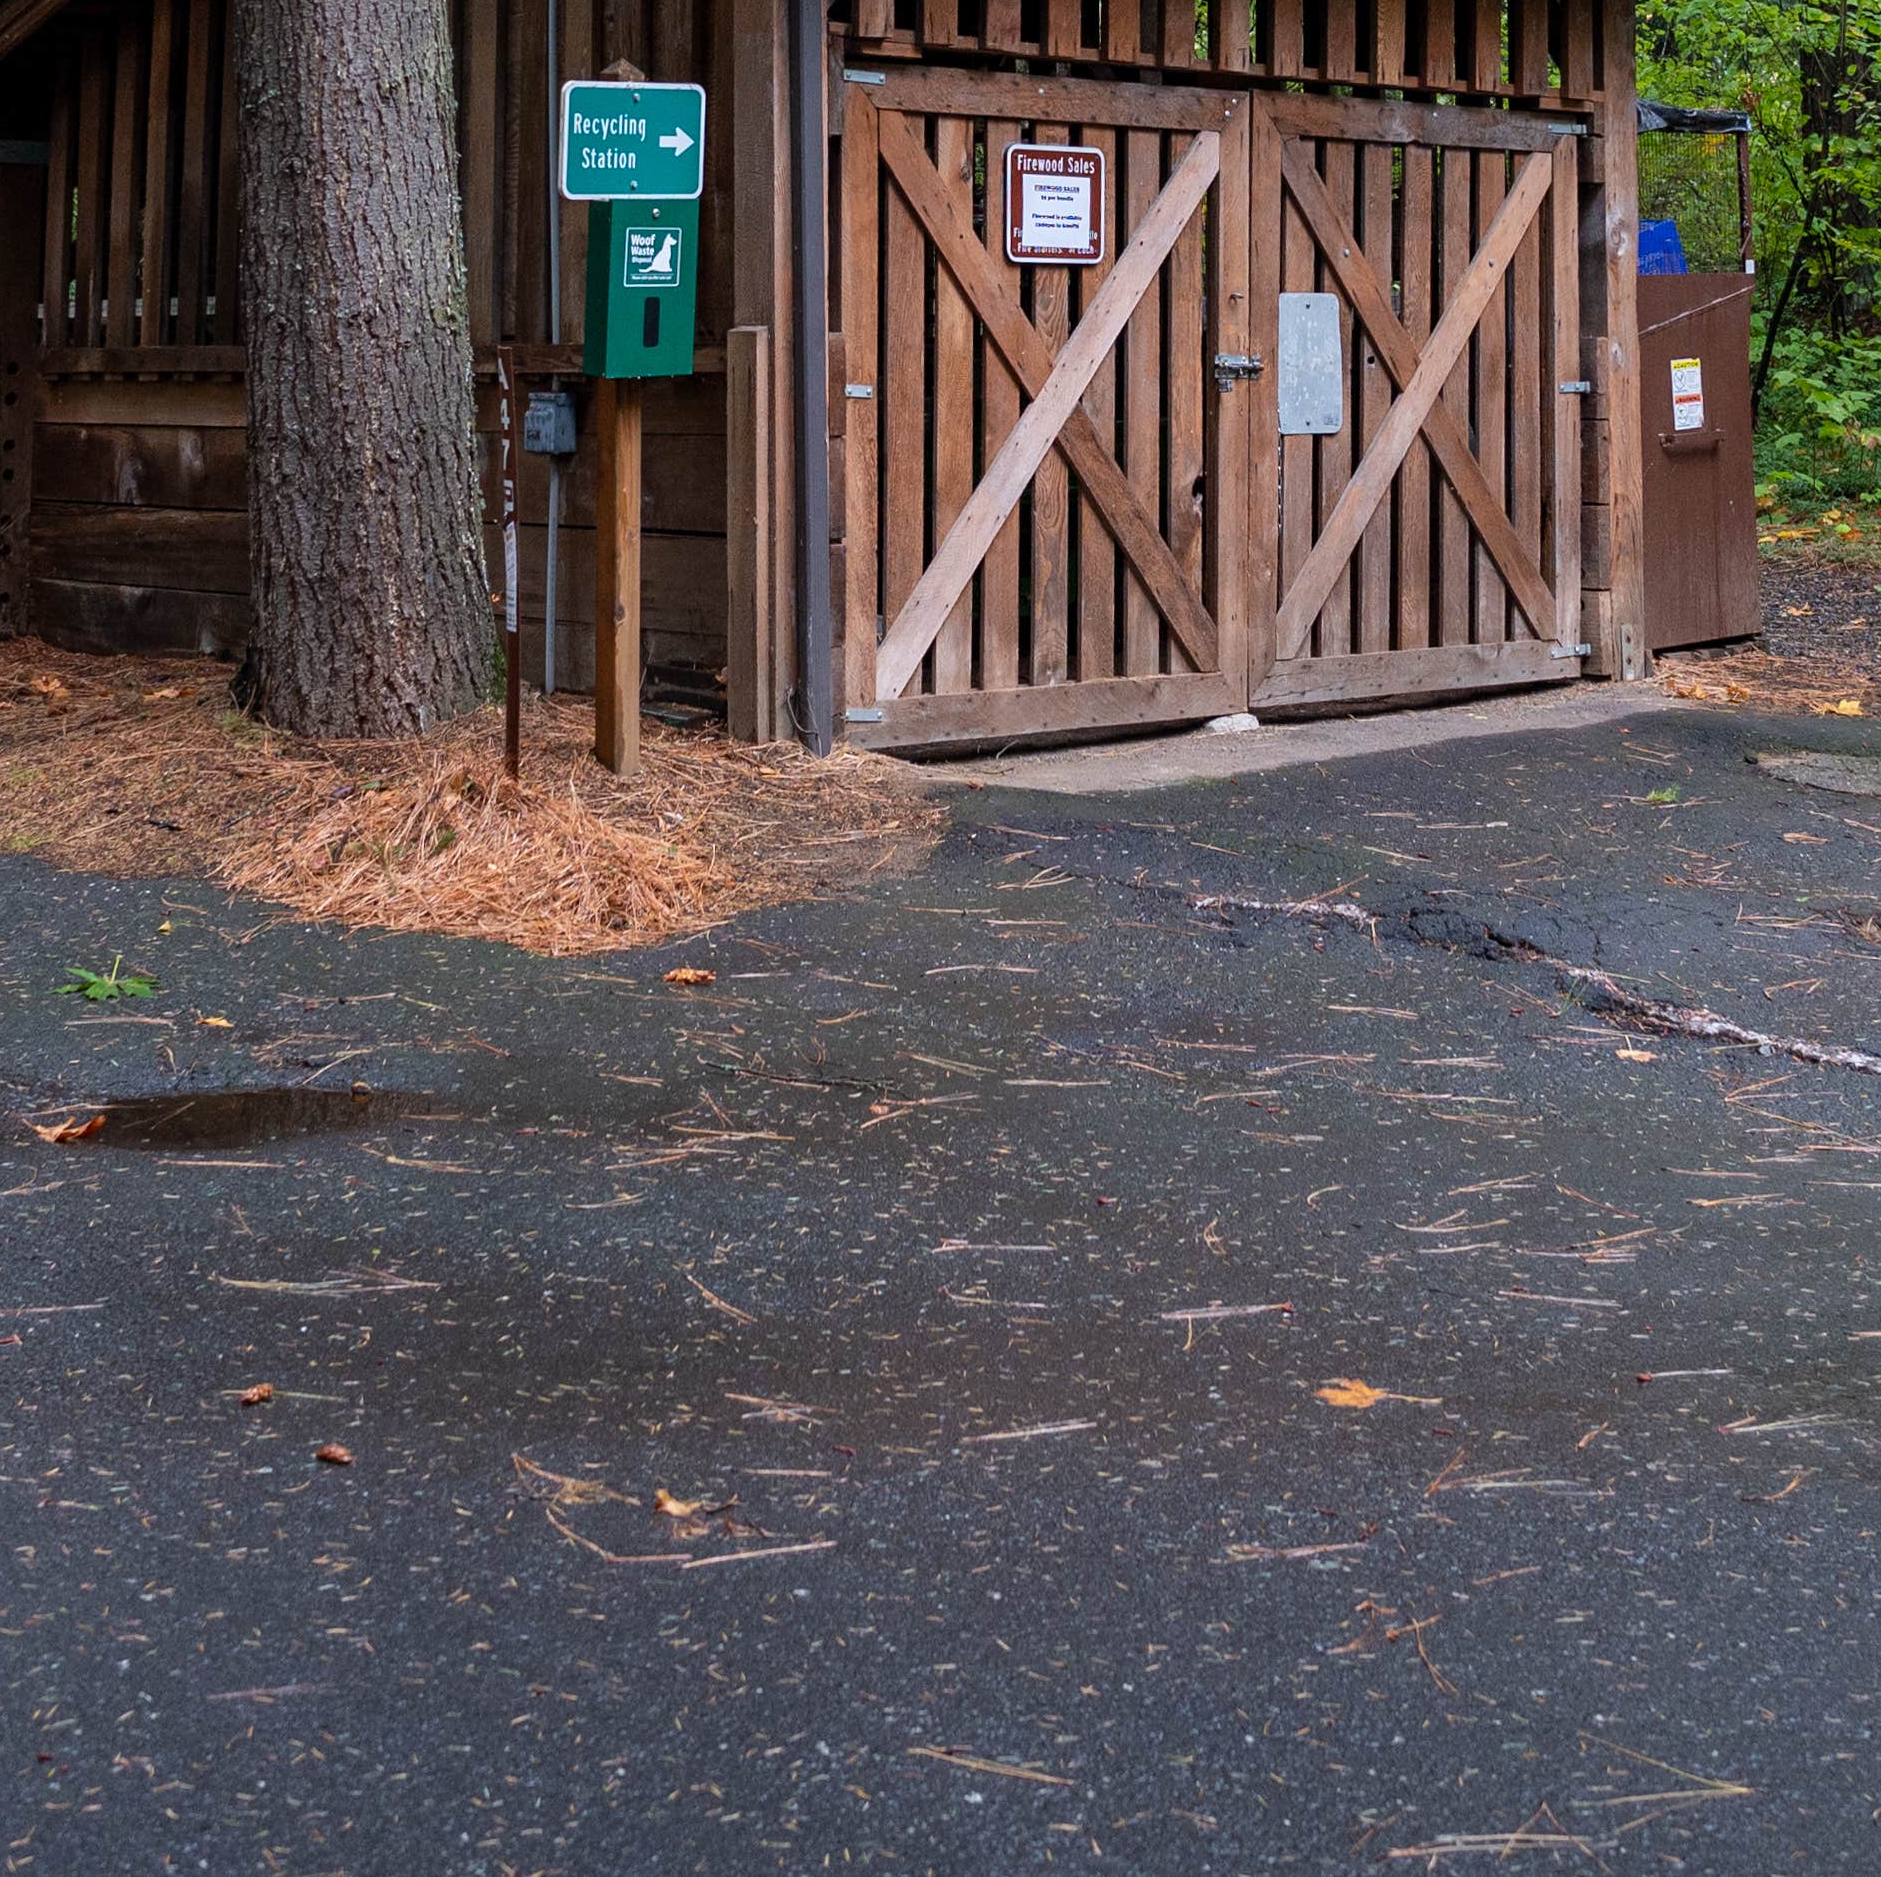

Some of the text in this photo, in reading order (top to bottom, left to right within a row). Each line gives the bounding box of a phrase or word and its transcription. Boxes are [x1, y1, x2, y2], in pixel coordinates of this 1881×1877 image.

[573, 112, 647, 142] Recycling
[581, 147, 636, 170] Station
[1017, 154, 1096, 175] Firewood Sales
[631, 233, 656, 246] Woof
[631, 246, 655, 256] Waste
